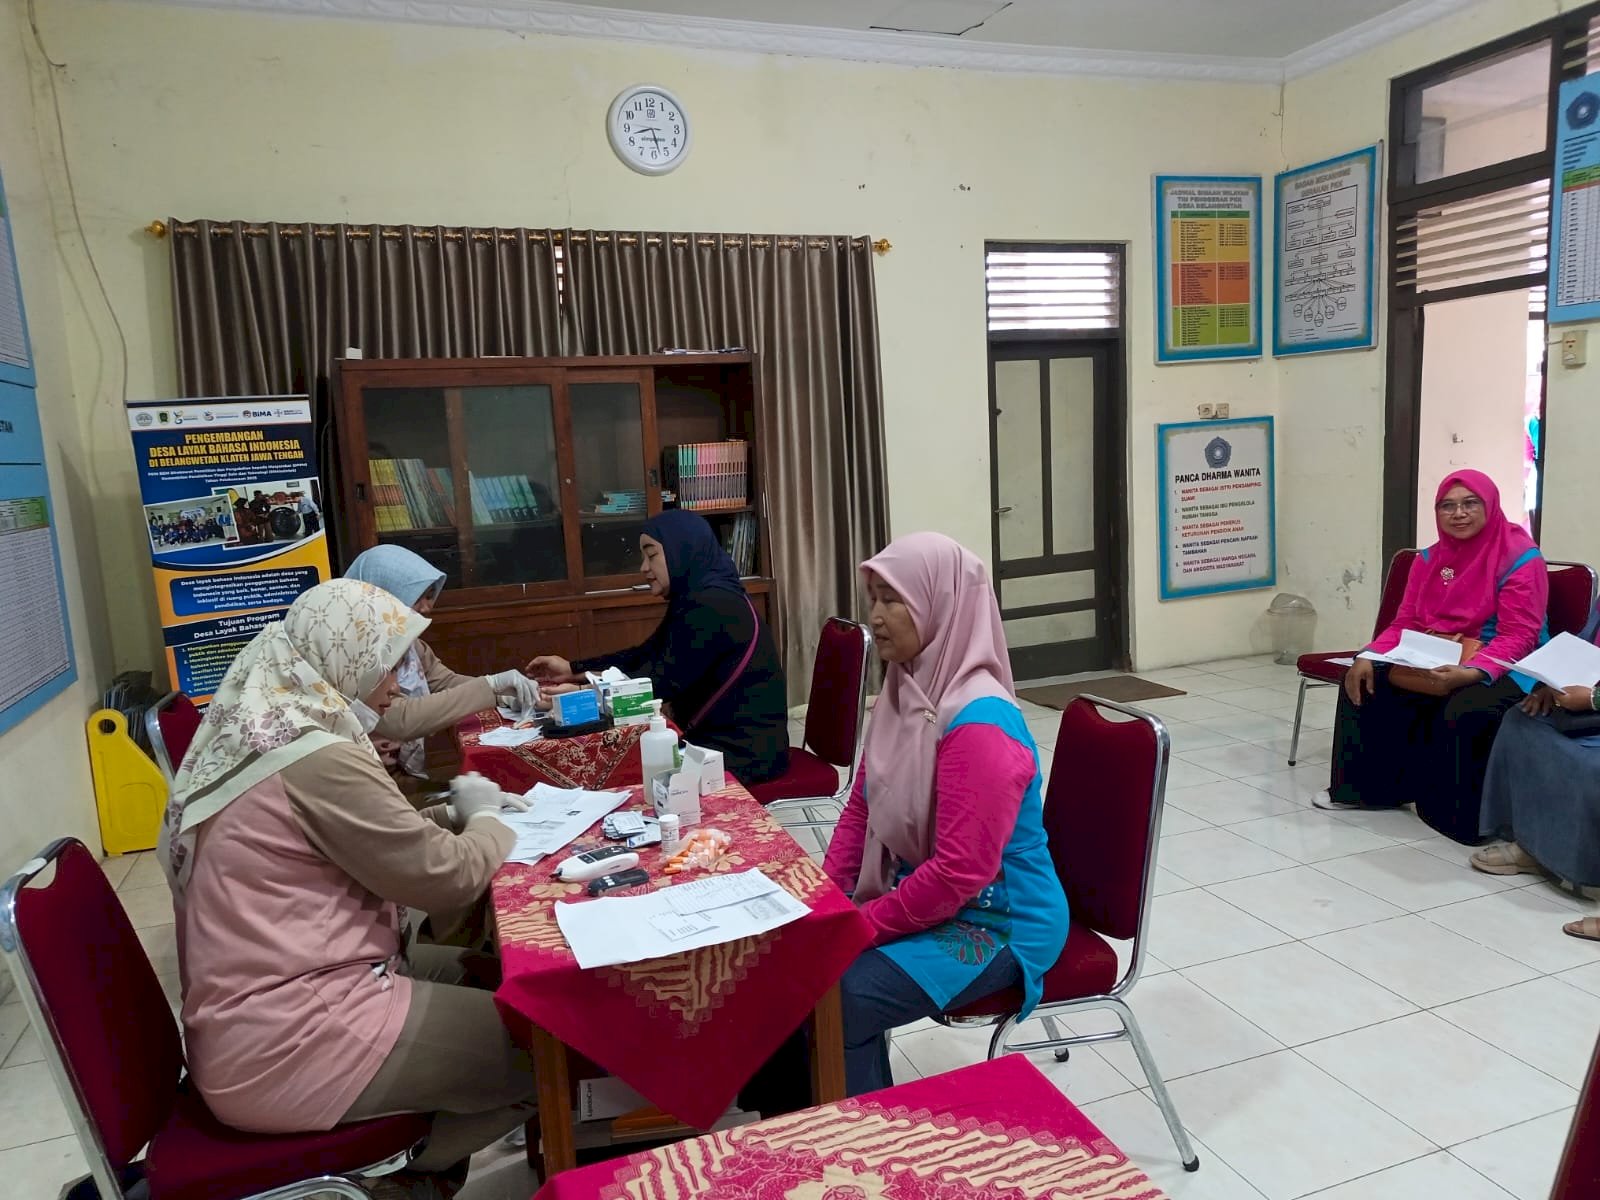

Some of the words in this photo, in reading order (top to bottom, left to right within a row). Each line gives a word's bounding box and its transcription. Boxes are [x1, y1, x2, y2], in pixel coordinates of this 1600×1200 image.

[634, 102, 642, 111] 11
[645, 98, 655, 108] 12
[660, 102, 664, 111] 1
[626, 111, 634, 120] 10
[668, 112, 675, 121] 2
[624, 123, 630, 133] 9
[674, 125, 680, 134] 3
[628, 137, 635, 146] 8
[671, 137, 677, 147] 4
[638, 146, 644, 156] 7
[651, 150, 657, 159] 6
[663, 147, 669, 156] 5
[185, 431, 264, 444] PENGEMBANGAN
[149, 446, 176, 458] DESA
[177, 444, 208, 456] LAYAK
[208, 442, 248, 454] BAHASA
[250, 440, 300, 452] INDONESIA
[148, 458, 158, 468] DI
[160, 456, 220, 467] BELANGWETAN
[220, 454, 250, 463] KLATEN
[251, 452, 272, 461] JAWA
[272, 450, 304, 460] TENGAH
[1175, 473, 1200, 484] PANCA
[1202, 470, 1232, 480] DHARMA
[1234, 468, 1261, 478] WANITA
[218, 618, 246, 627] Tujuan
[246, 612, 280, 622] Program
[194, 630, 214, 639] Desa
[214, 625, 238, 635] Layak
